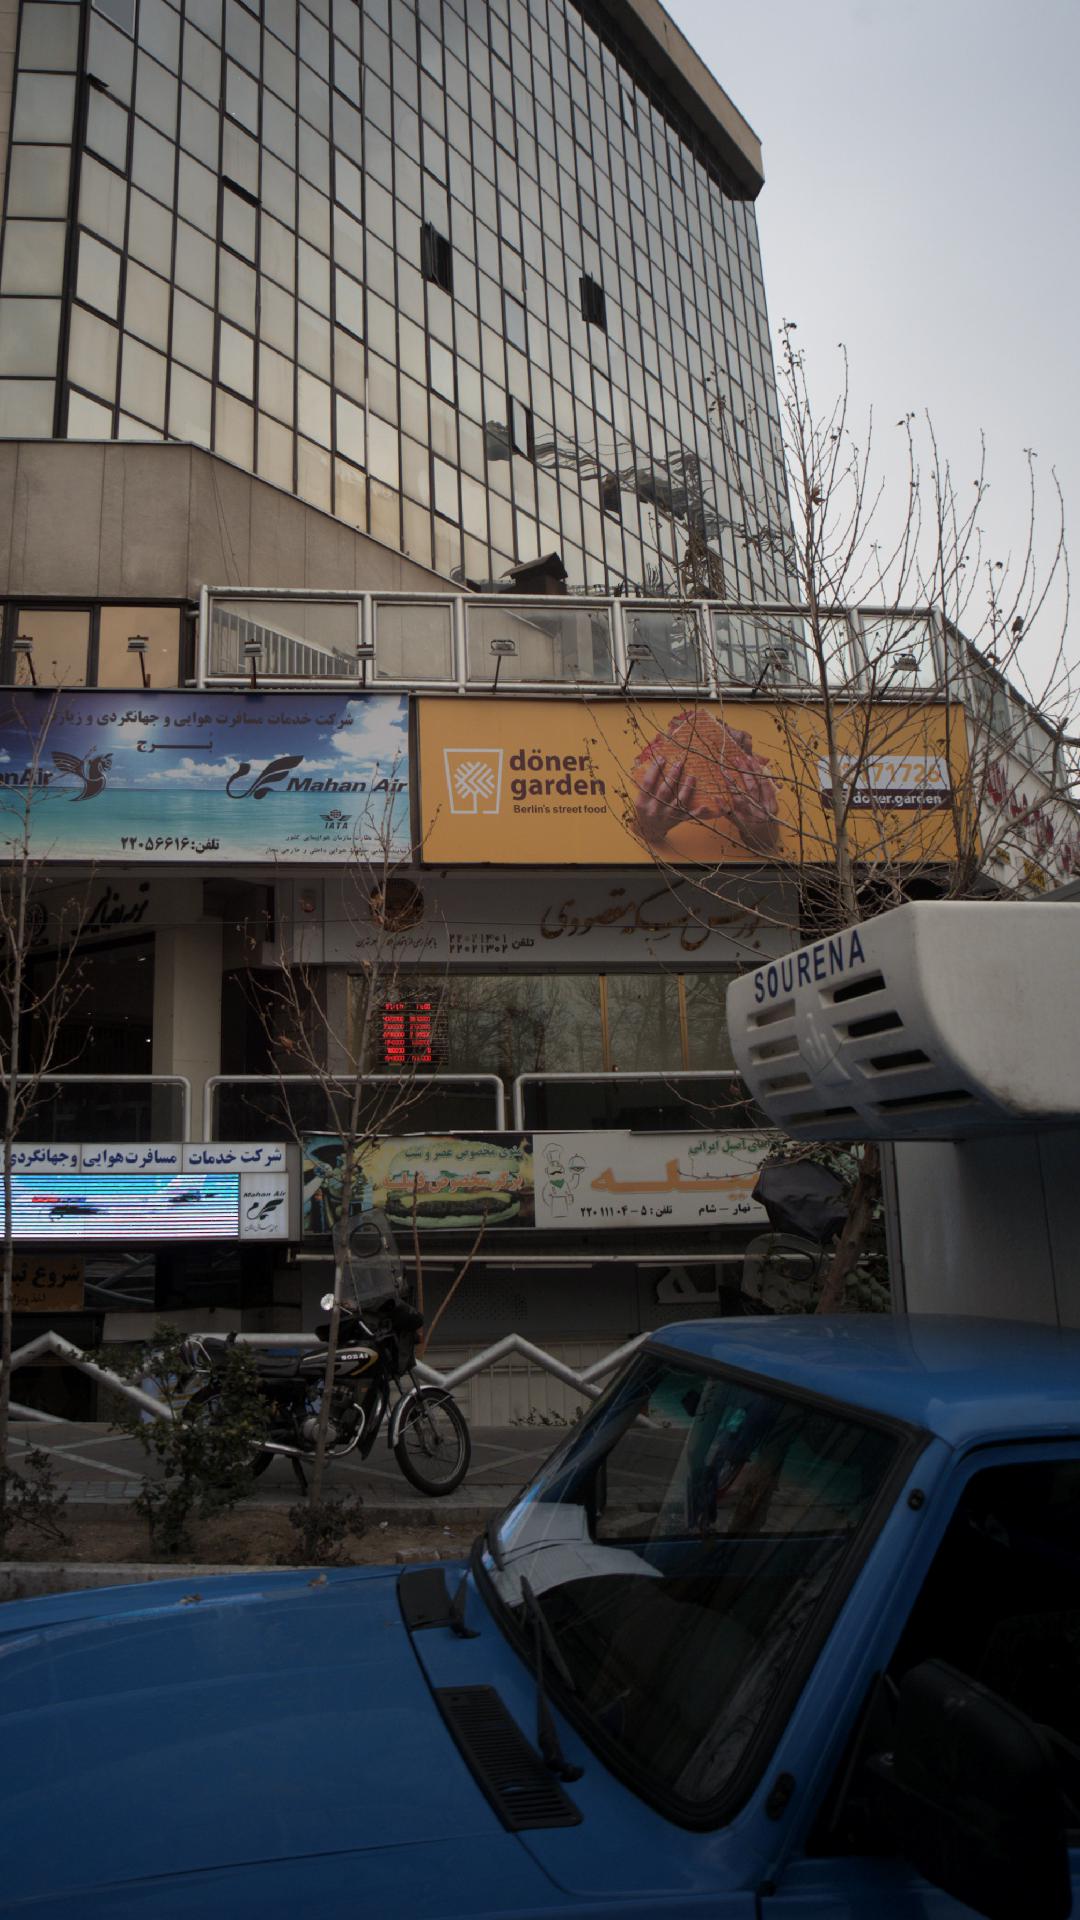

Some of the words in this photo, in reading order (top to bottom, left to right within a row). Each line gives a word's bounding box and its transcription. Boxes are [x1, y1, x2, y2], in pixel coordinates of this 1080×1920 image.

[97, 710, 159, 727] جهانگردی
[174, 711, 211, 727] هوایی
[216, 711, 262, 728] مسافرت
[268, 712, 311, 726] خدمات
[316, 711, 353, 729] شرکت
[510, 749, 591, 771] döner
[287, 778, 366, 792] Mahan
[373, 777, 408, 792] Air
[511, 774, 606, 801] garden
[514, 804, 551, 815] Berlin's
[553, 804, 582, 815] street
[584, 804, 607, 815] food
[324, 821, 349, 829] IATA
[754, 930, 865, 1003] SOURENA
[83, 1149, 124, 1168] هوایی
[126, 1149, 177, 1168] مسافرت
[189, 1149, 237, 1165] خدمات
[241, 1147, 282, 1167] شرکت
[698, 1204, 717, 1217] شام
[33, 1264, 81, 1288] شروع
